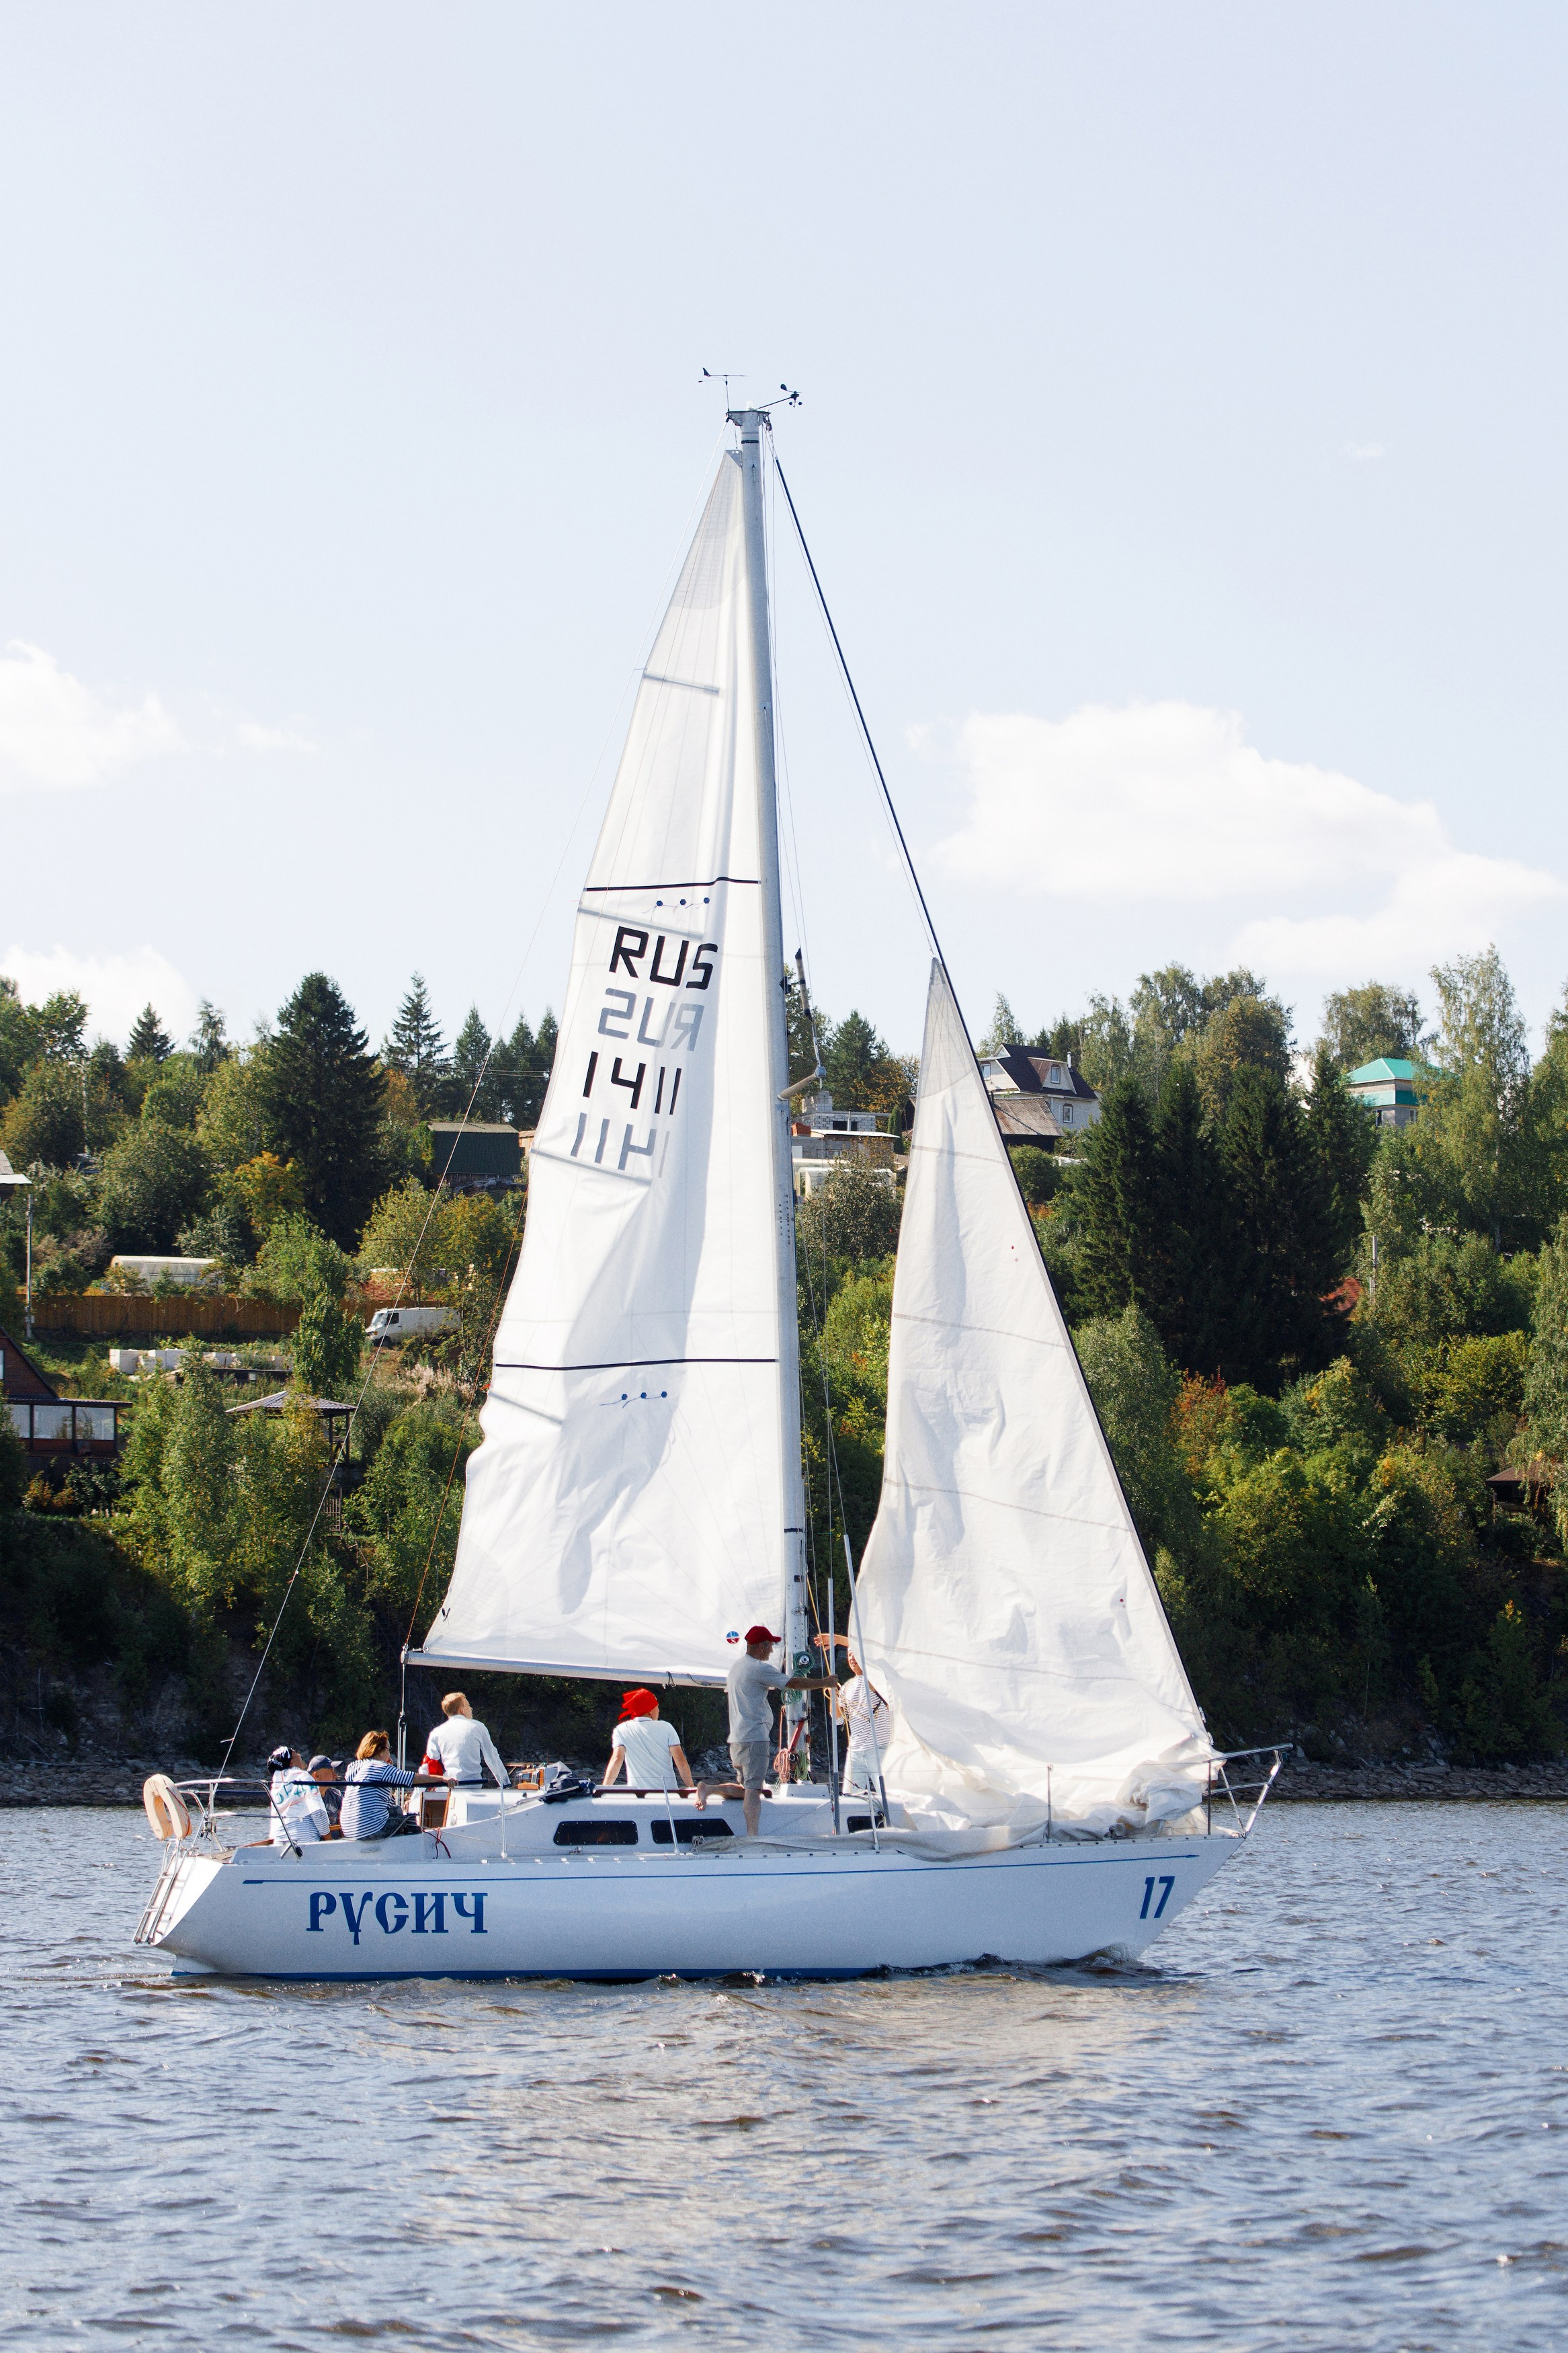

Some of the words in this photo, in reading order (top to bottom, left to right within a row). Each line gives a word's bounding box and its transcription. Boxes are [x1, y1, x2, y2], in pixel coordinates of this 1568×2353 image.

[609, 926, 718, 990] RUS
[583, 1051, 682, 1115] 1411
[306, 1891, 488, 1945] РУСИЧ
[1139, 1876, 1175, 1919] 17
